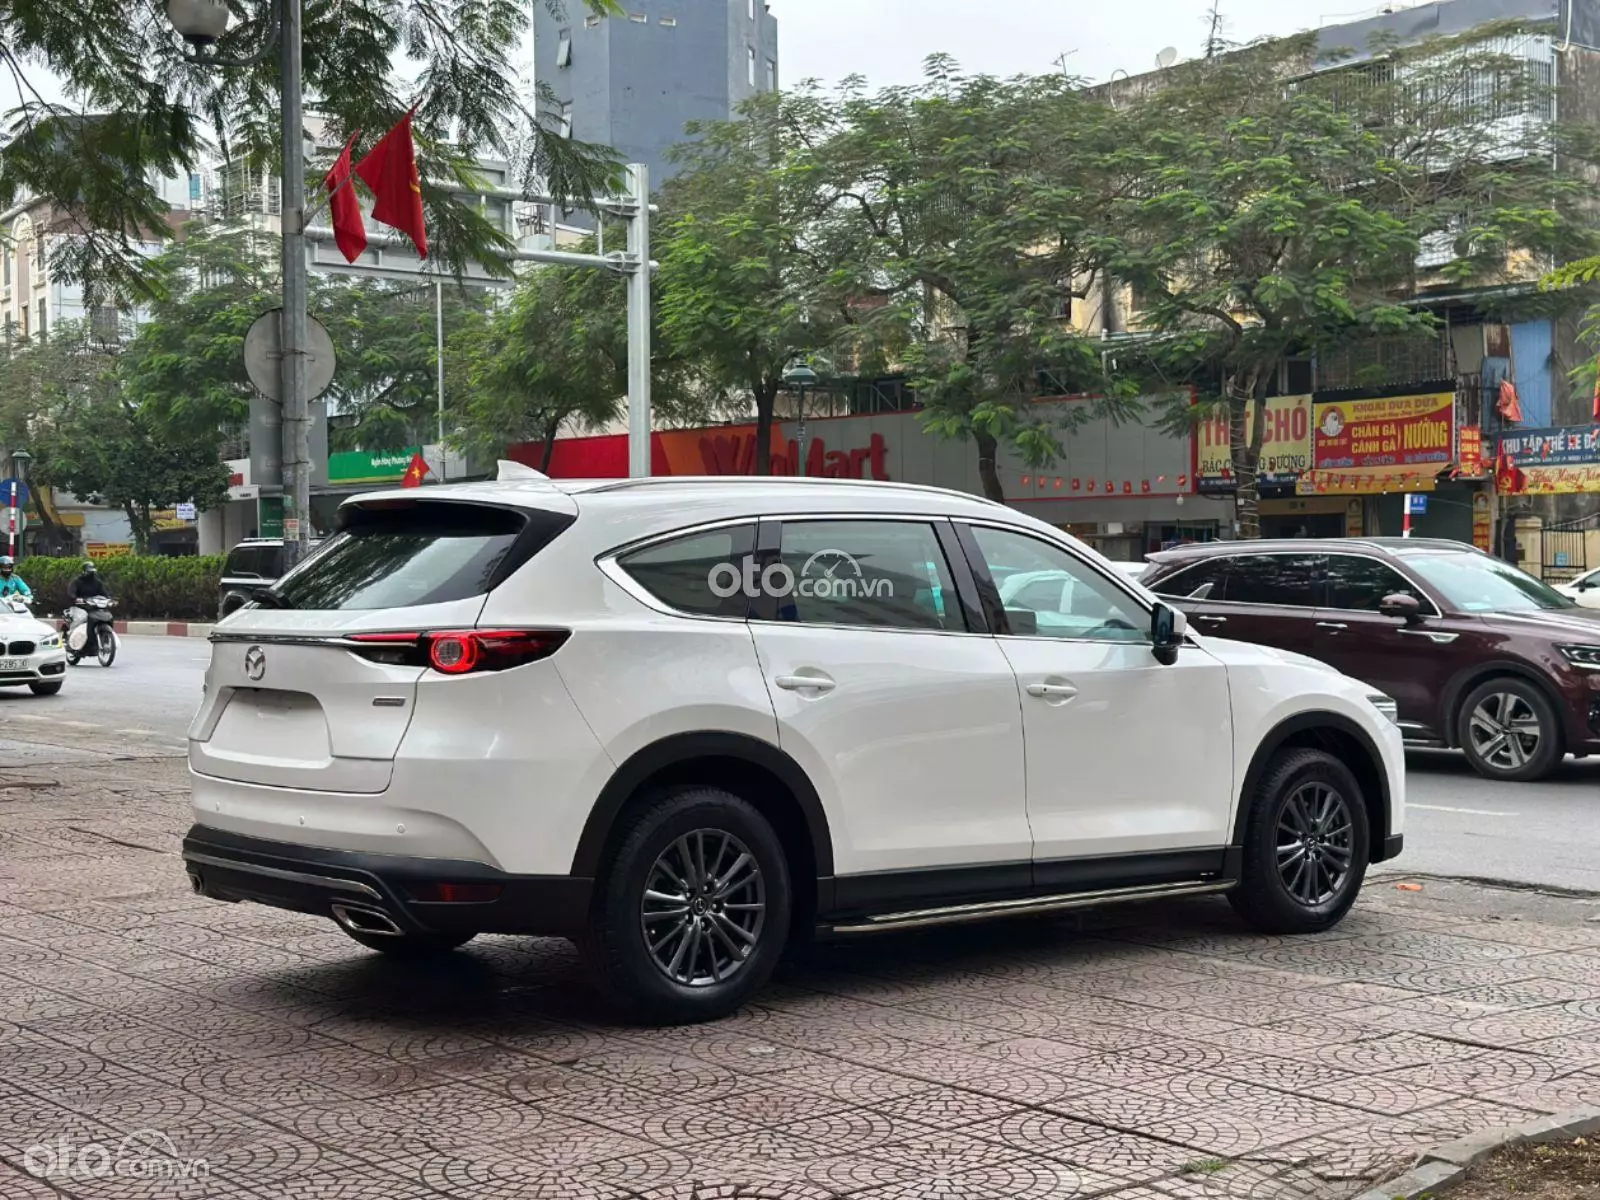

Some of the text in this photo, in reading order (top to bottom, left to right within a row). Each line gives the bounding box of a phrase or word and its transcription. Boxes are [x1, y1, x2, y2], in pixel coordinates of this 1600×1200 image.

[1262, 399, 1307, 444] CHÓ
[1351, 421, 1397, 438] CHÂN GÀ
[1403, 416, 1448, 449] NƯỚNG
[1351, 438, 1380, 454] CÁNH
[1382, 437, 1397, 452] GÀ
